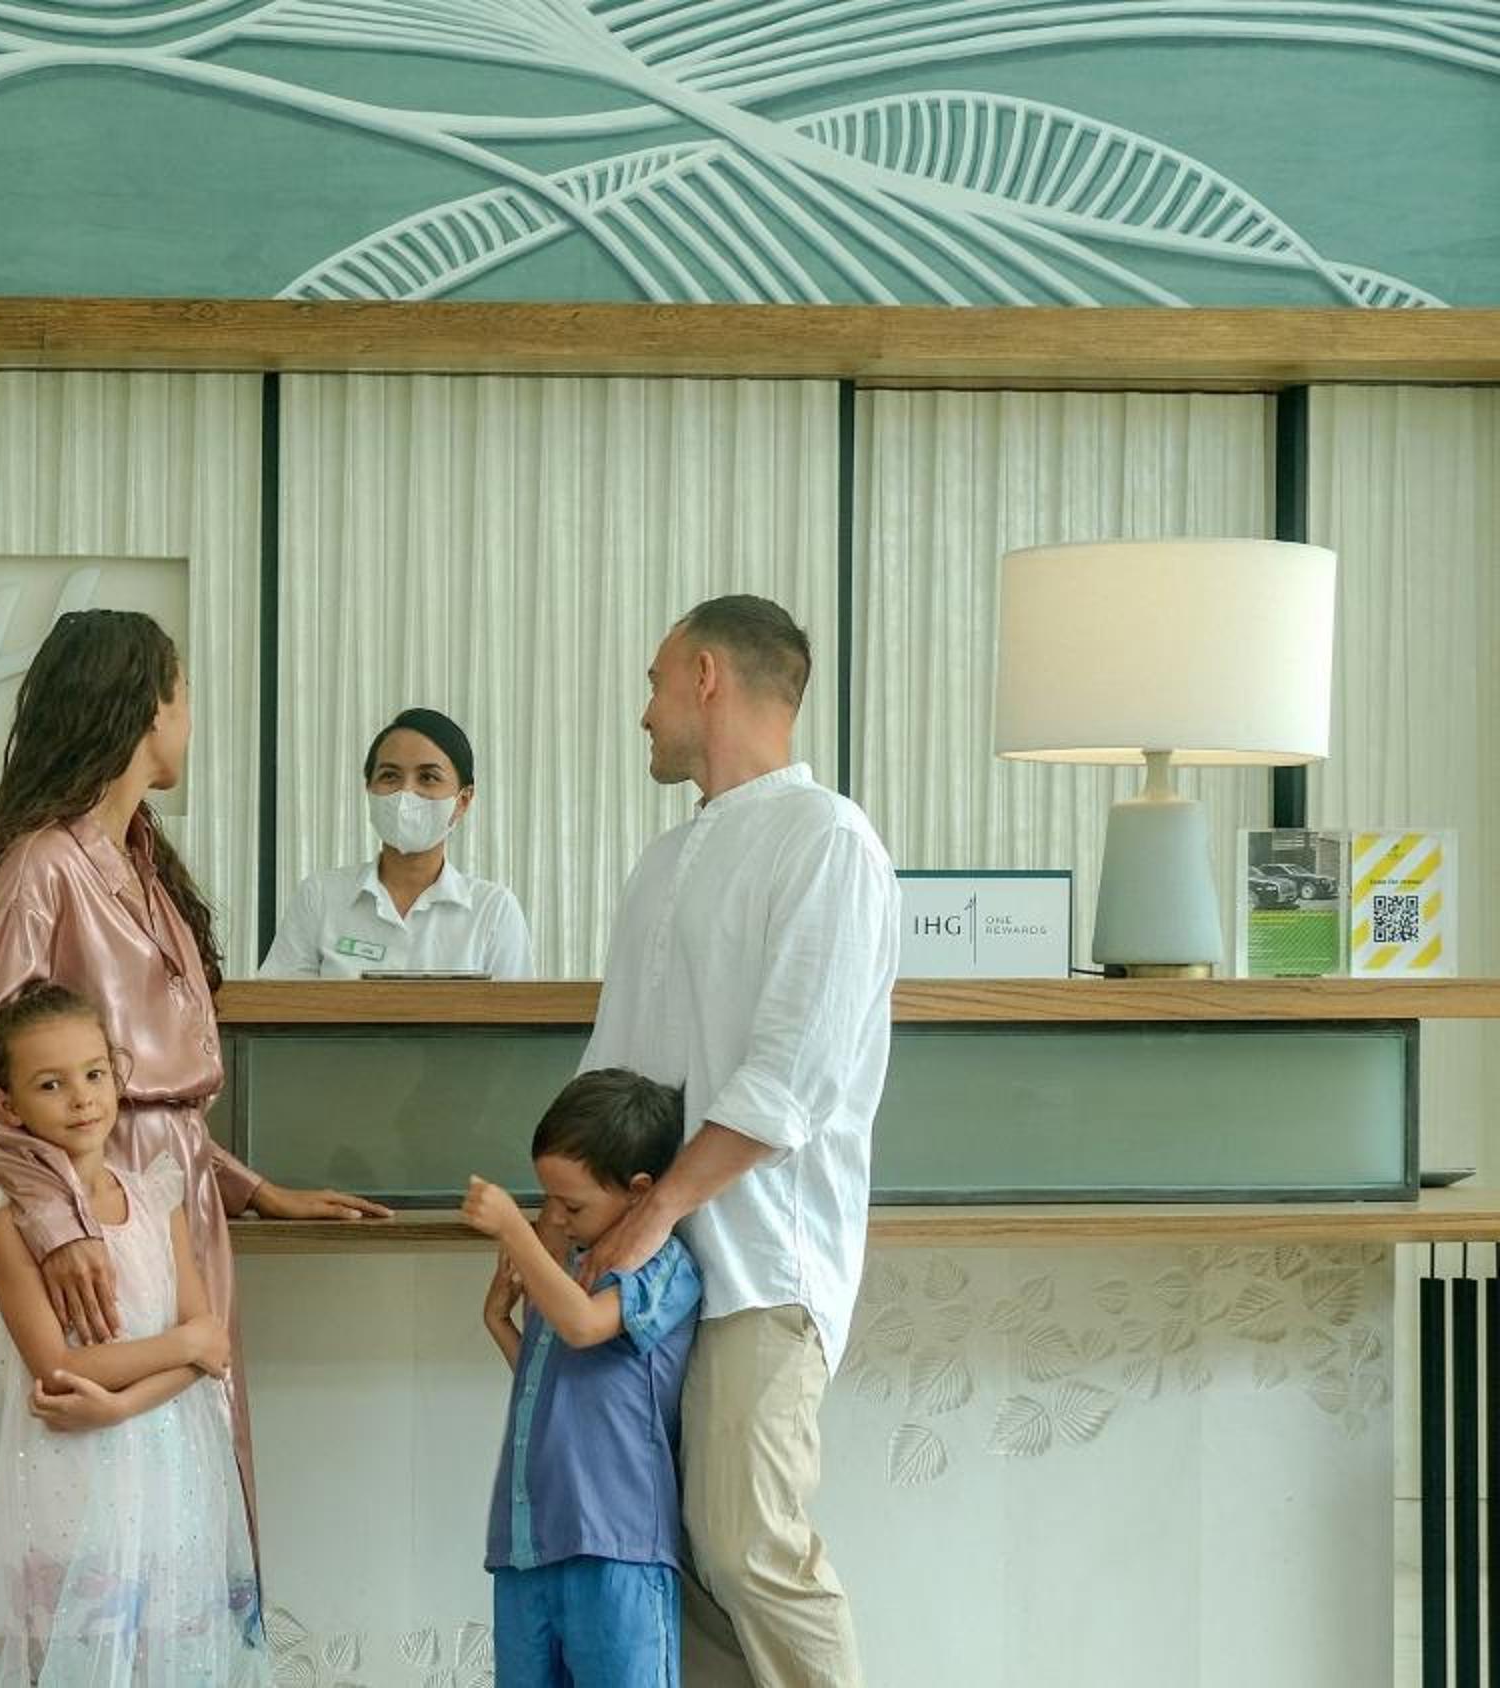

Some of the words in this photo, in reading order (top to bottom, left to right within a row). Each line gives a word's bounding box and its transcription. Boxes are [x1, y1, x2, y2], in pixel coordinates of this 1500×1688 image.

[914, 915, 962, 935] IHG
[985, 915, 1013, 925] ONE
[985, 926, 1048, 935] REWARDS
